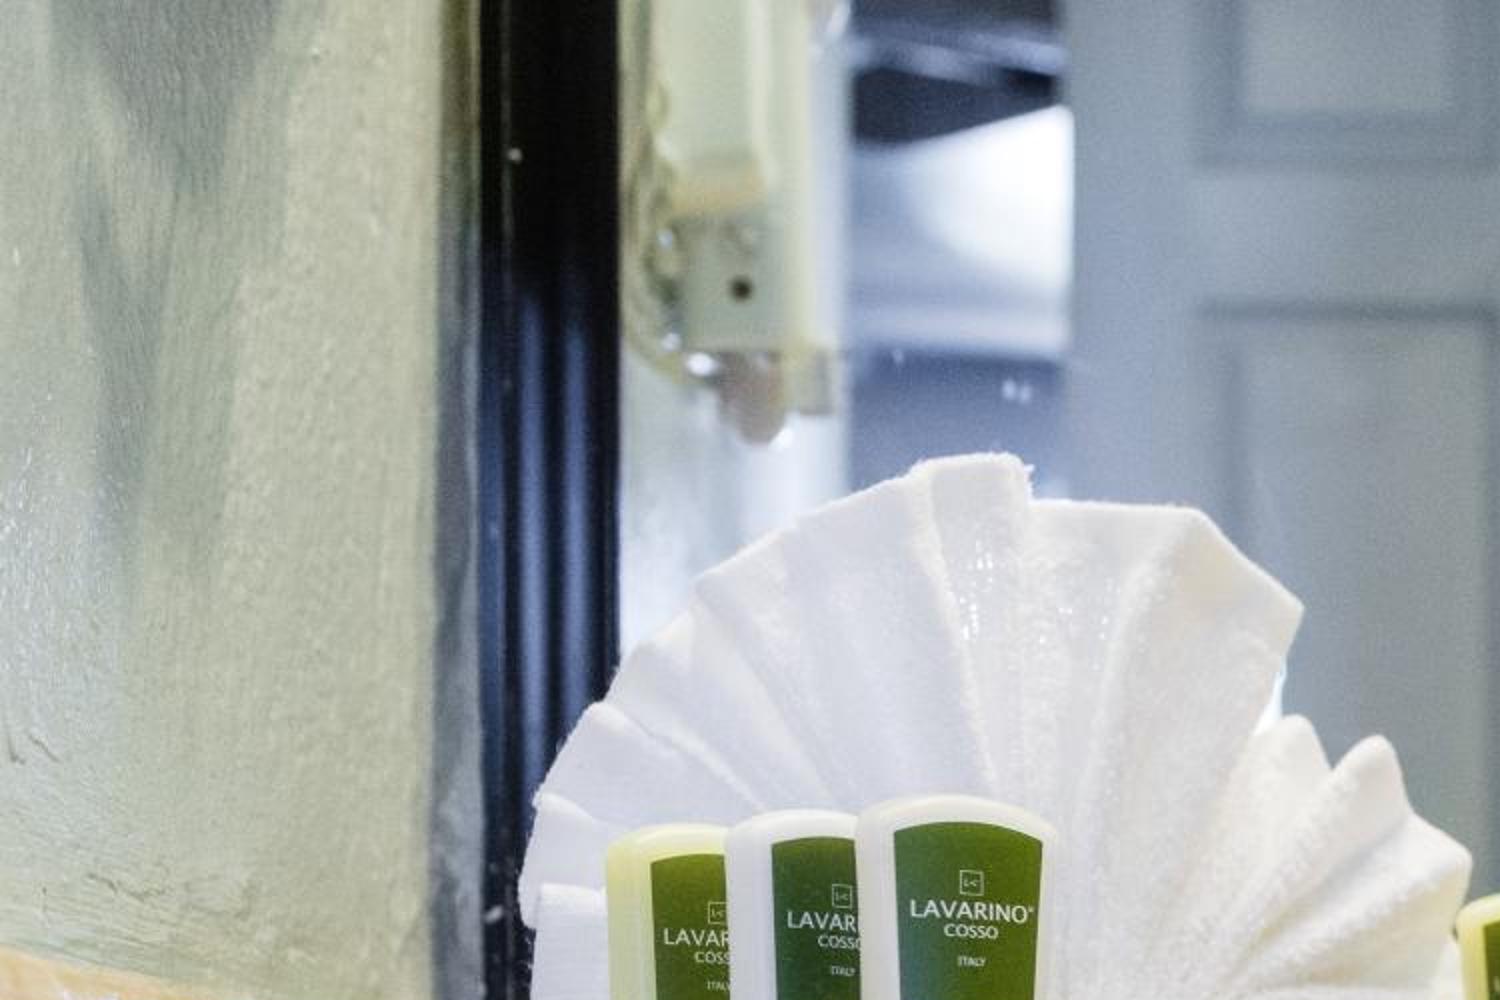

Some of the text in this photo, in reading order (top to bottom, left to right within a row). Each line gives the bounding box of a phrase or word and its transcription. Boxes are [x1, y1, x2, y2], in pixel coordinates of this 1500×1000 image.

[909, 899, 1034, 924] LAVARINO
[943, 923, 999, 940] COSSO
[957, 955, 987, 967] ITALY
